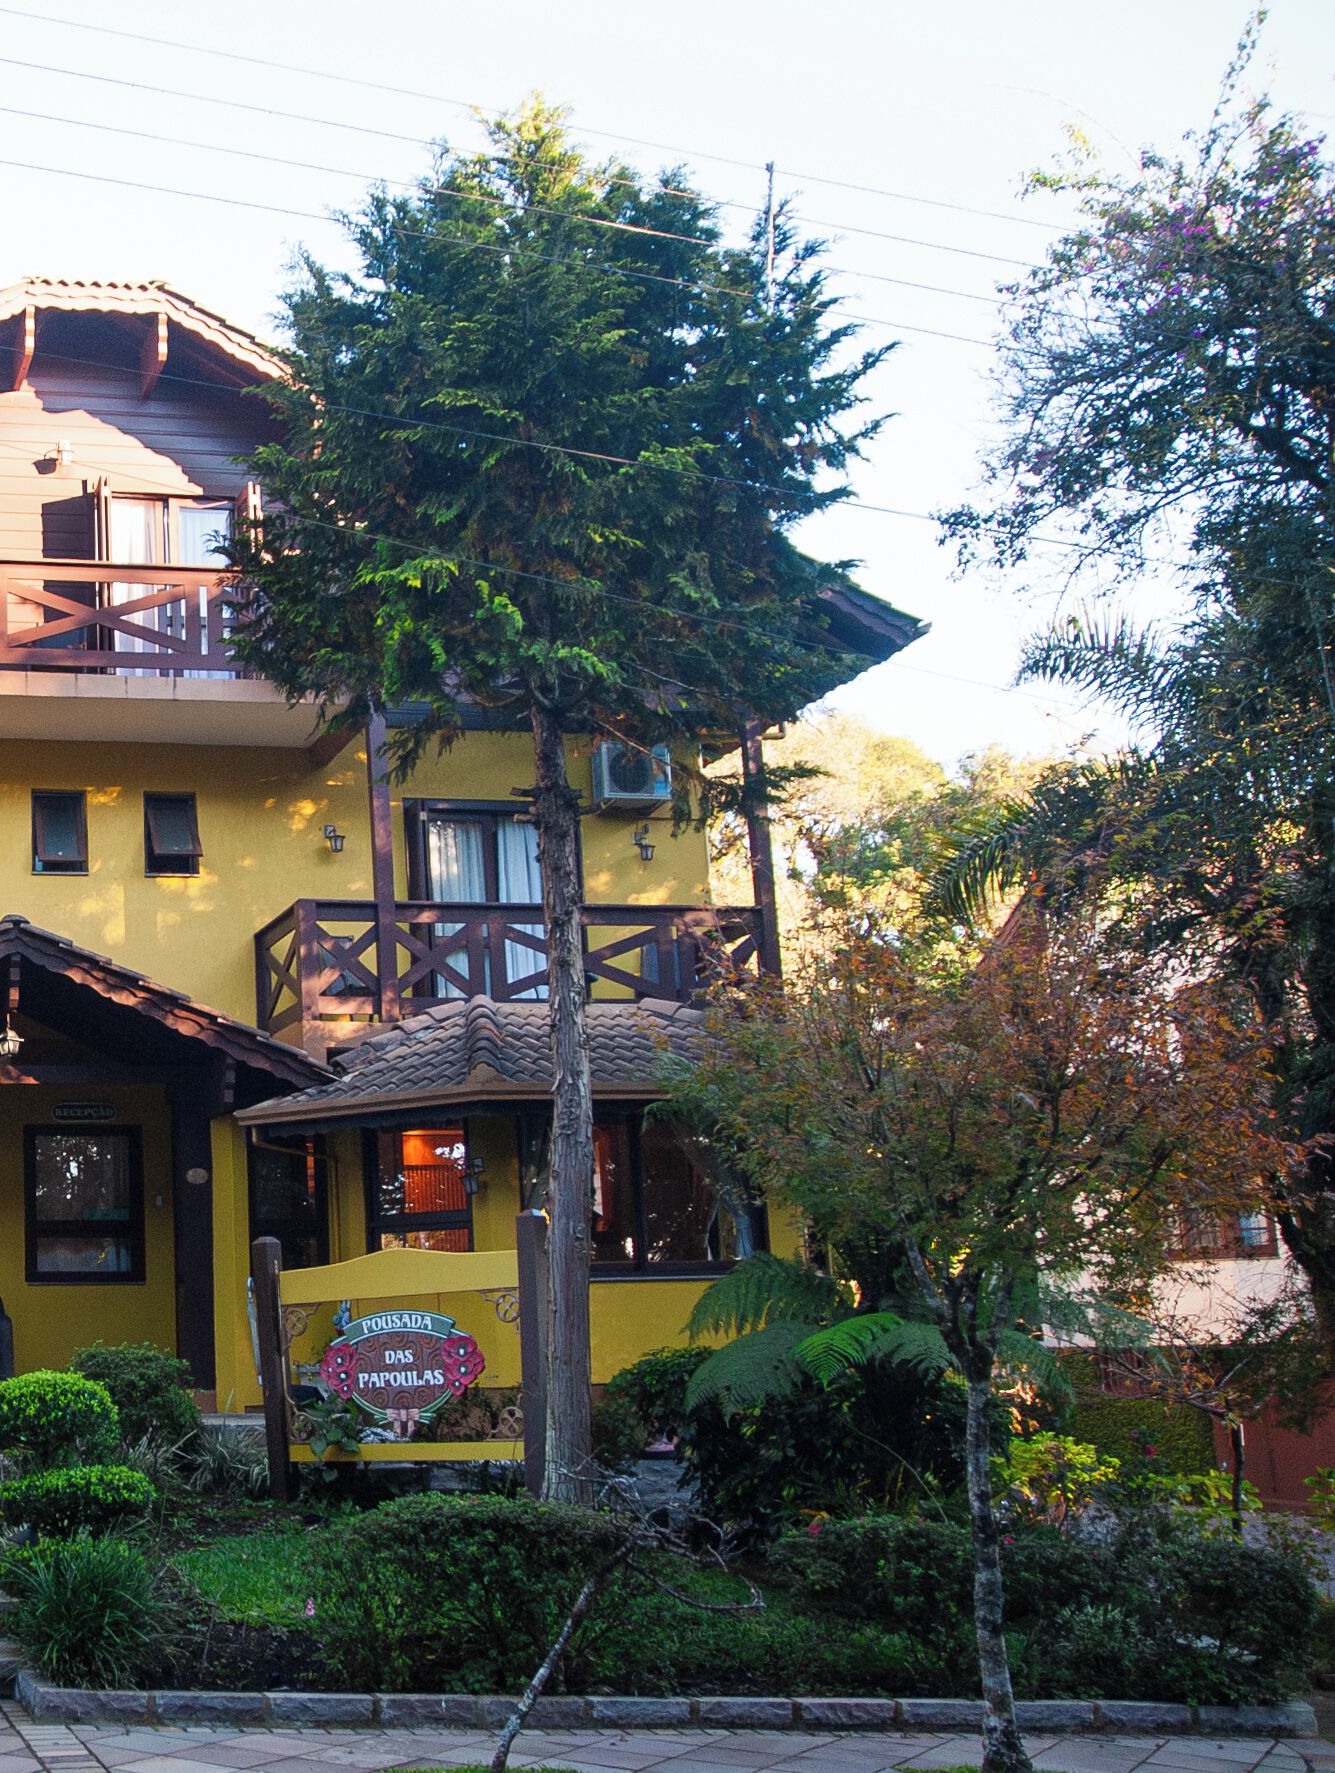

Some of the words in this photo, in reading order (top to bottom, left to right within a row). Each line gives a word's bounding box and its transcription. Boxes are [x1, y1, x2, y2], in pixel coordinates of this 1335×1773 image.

[362, 1314, 432, 1334] POUSADA
[384, 1349, 414, 1364] DAS
[358, 1369, 444, 1388] PAPOULAS
